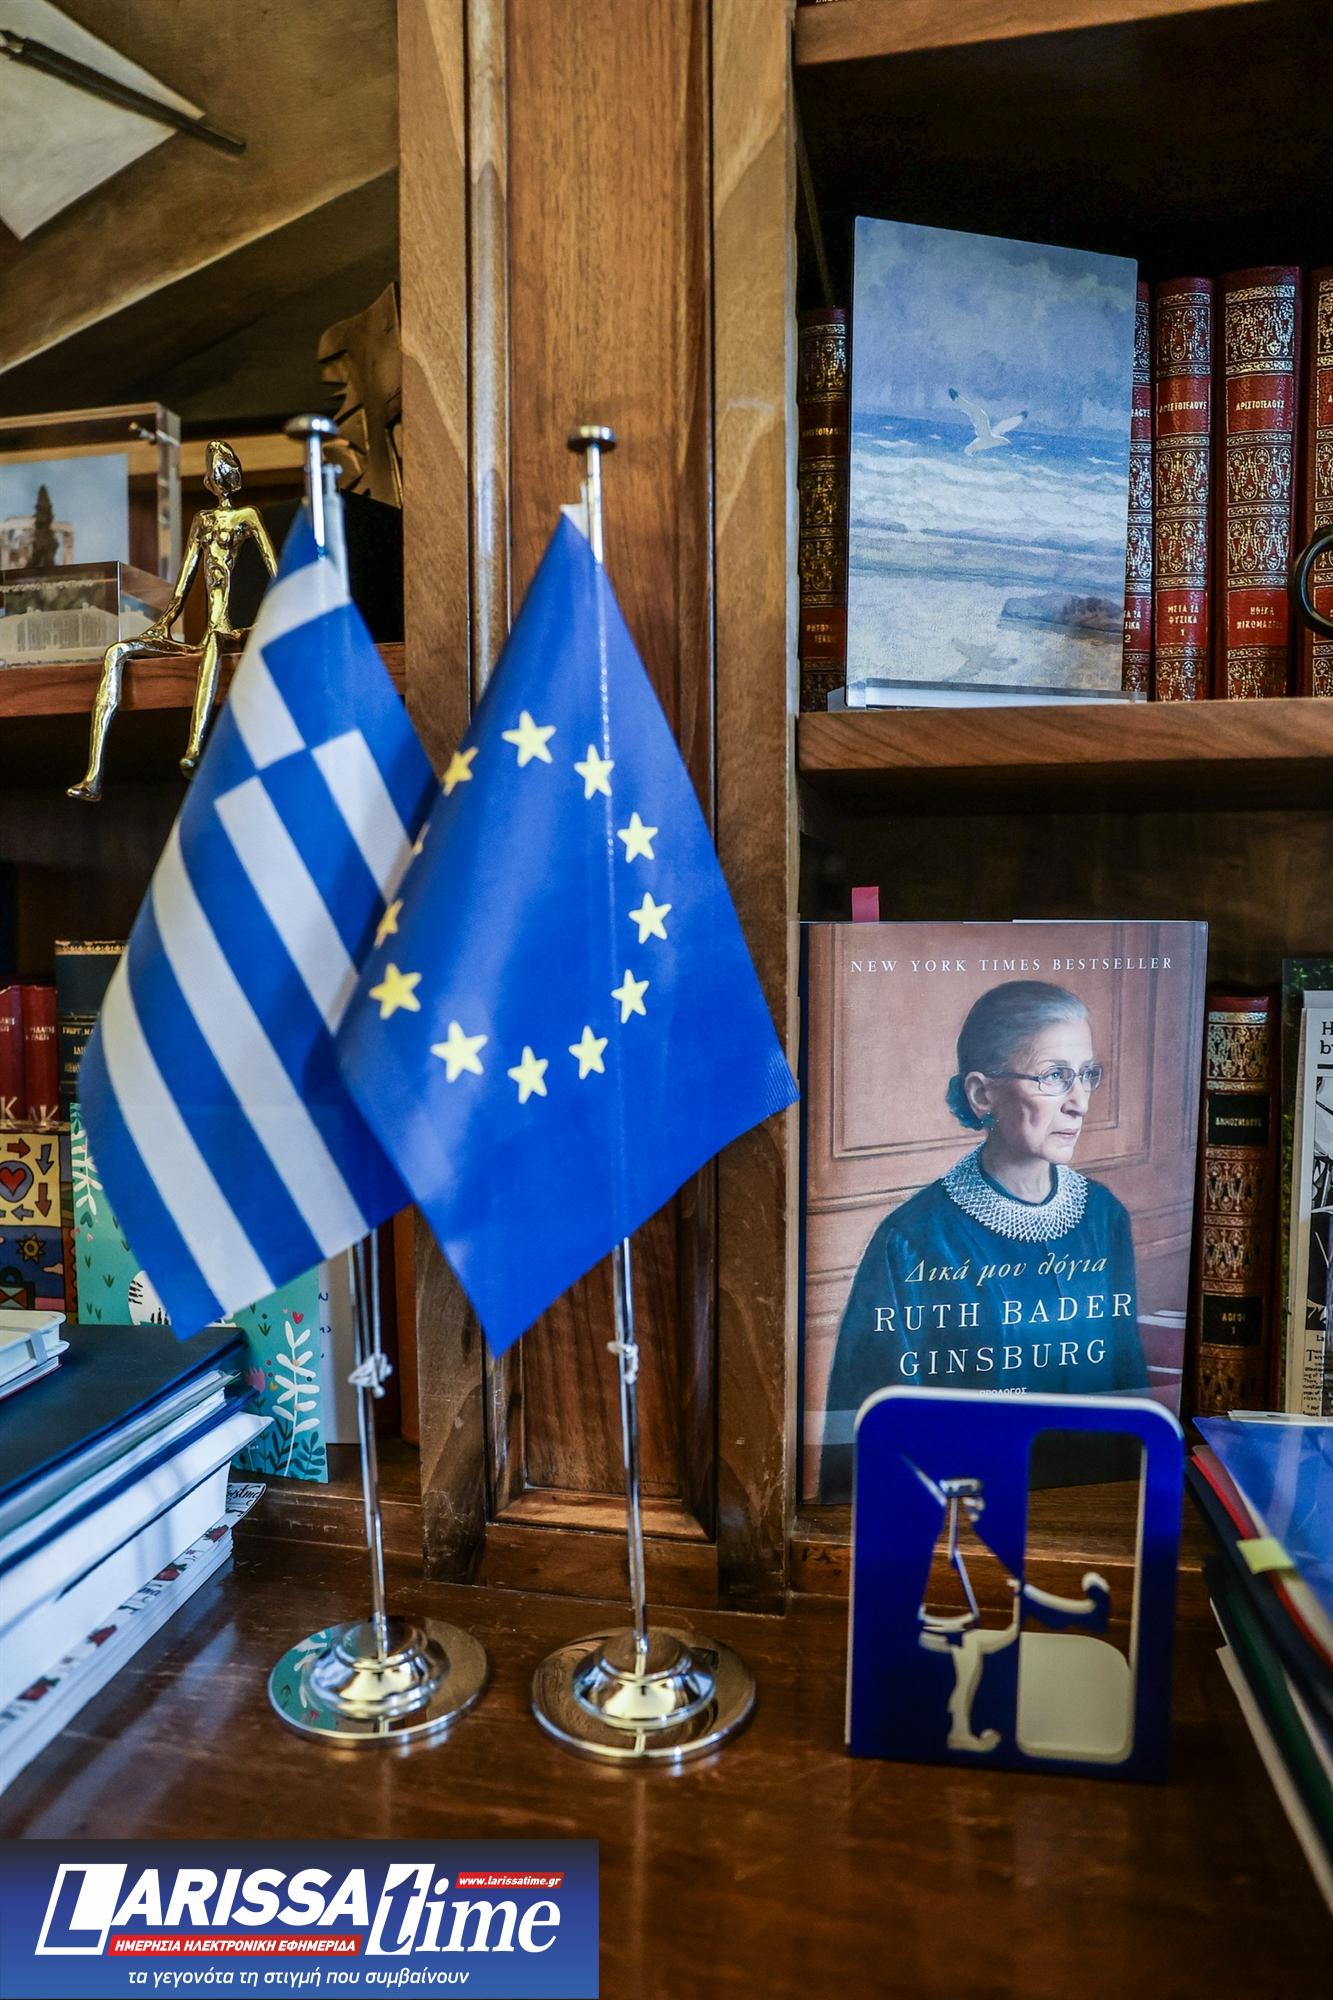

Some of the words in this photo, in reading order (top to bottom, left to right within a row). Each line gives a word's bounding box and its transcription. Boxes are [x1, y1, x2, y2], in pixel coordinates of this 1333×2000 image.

[850, 960, 897, 972] NEW
[911, 959, 966, 972] YORK
[979, 959, 1041, 971] TIMES
[1052, 957, 1172, 971] BESTSELLER
[904, 1258, 971, 1283] Δικά
[976, 1263, 1027, 1287] μου
[1037, 1253, 1107, 1282] λόγια
[874, 1302, 980, 1332] RUTH
[1002, 1293, 1132, 1325] BADER
[899, 1339, 1106, 1377] GINSBURG
